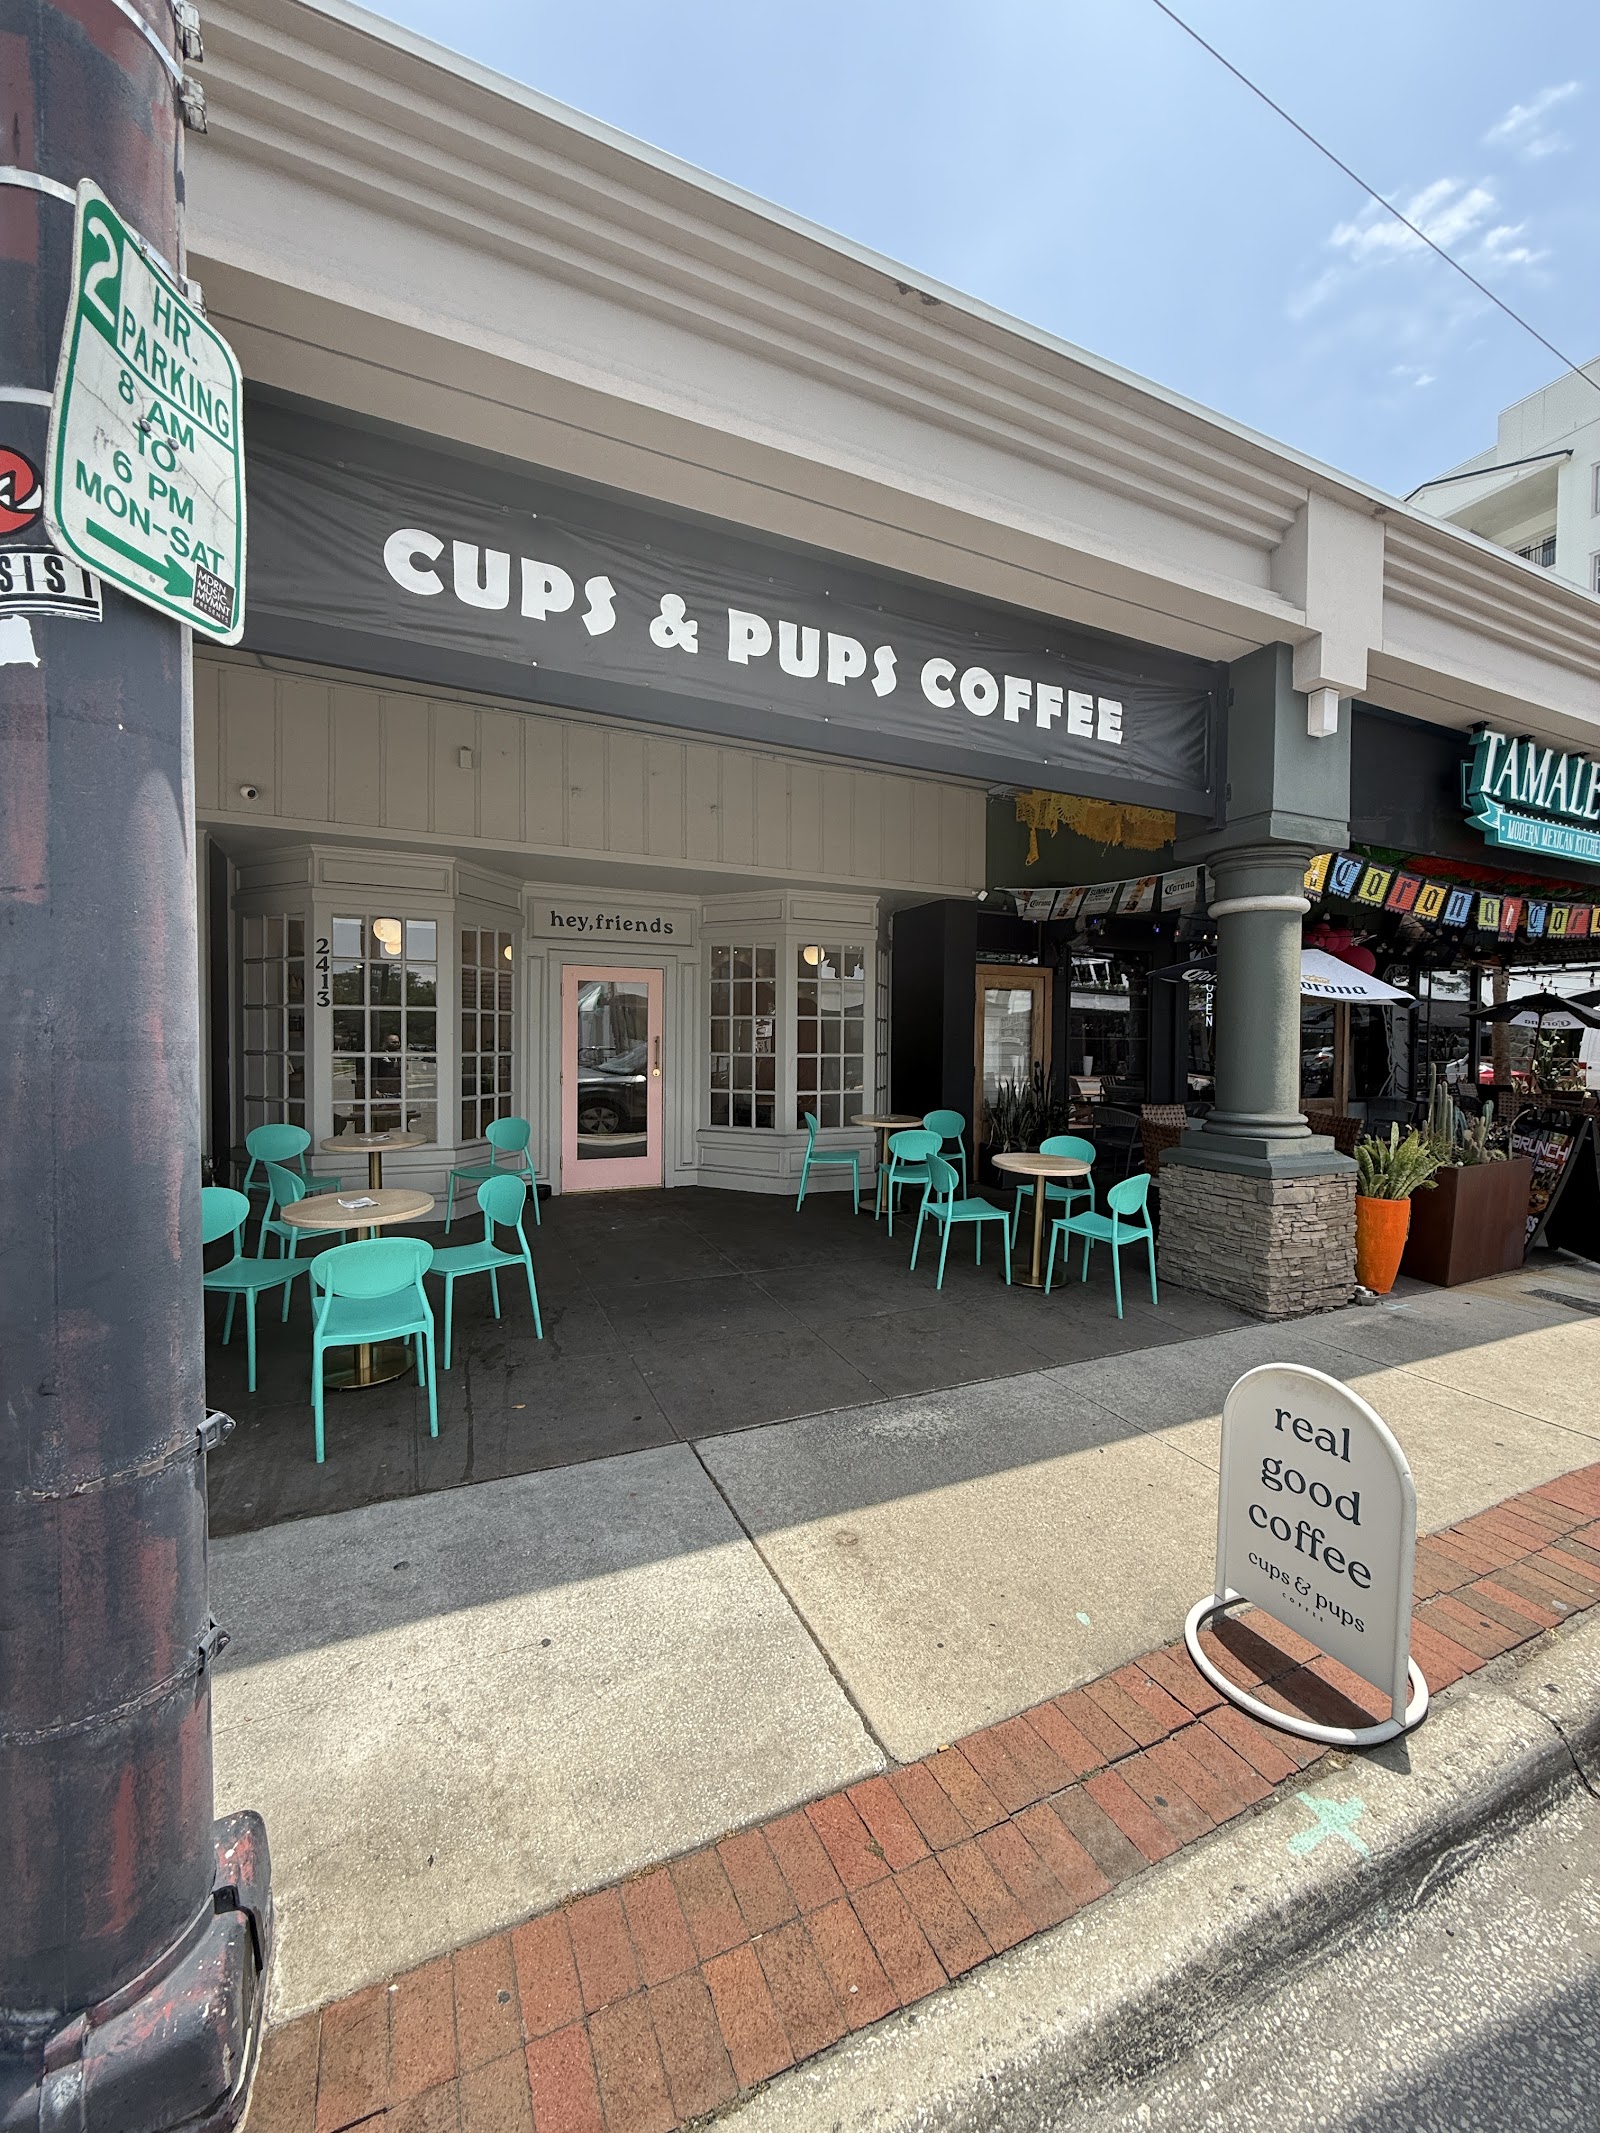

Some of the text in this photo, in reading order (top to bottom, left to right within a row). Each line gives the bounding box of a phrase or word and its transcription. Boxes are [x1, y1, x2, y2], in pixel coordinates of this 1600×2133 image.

[84, 216, 199, 366] 2 HR.
[121, 304, 230, 438] PARKING
[118, 369, 195, 453] 8 AM
[132, 421, 177, 473] TO
[112, 450, 194, 525] 6 PM
[75, 458, 225, 575] MON-SAT
[196, 589, 231, 617] MVMNT
[197, 579, 228, 606] MUSIC
[198, 569, 227, 595] MDRN
[195, 598, 229, 624] PRESENTS
[383, 527, 1125, 745] CUPS & PUPS COFFEE
[1507, 819, 1540, 847] MODERN
[1541, 827, 1574, 852] MEXICAN
[1029, 900, 1052, 909] Corona
[1164, 879, 1196, 896] Corona
[315, 937, 331, 1008] 2413
[1300, 981, 1369, 995] orona
[1511, 1132, 1570, 1162] BRUNCH
[1274, 1408, 1352, 1463] real
[1261, 1457, 1362, 1526] good
[1248, 1504, 1372, 1589] coffee
[1248, 1552, 1365, 1633] cups & pups
